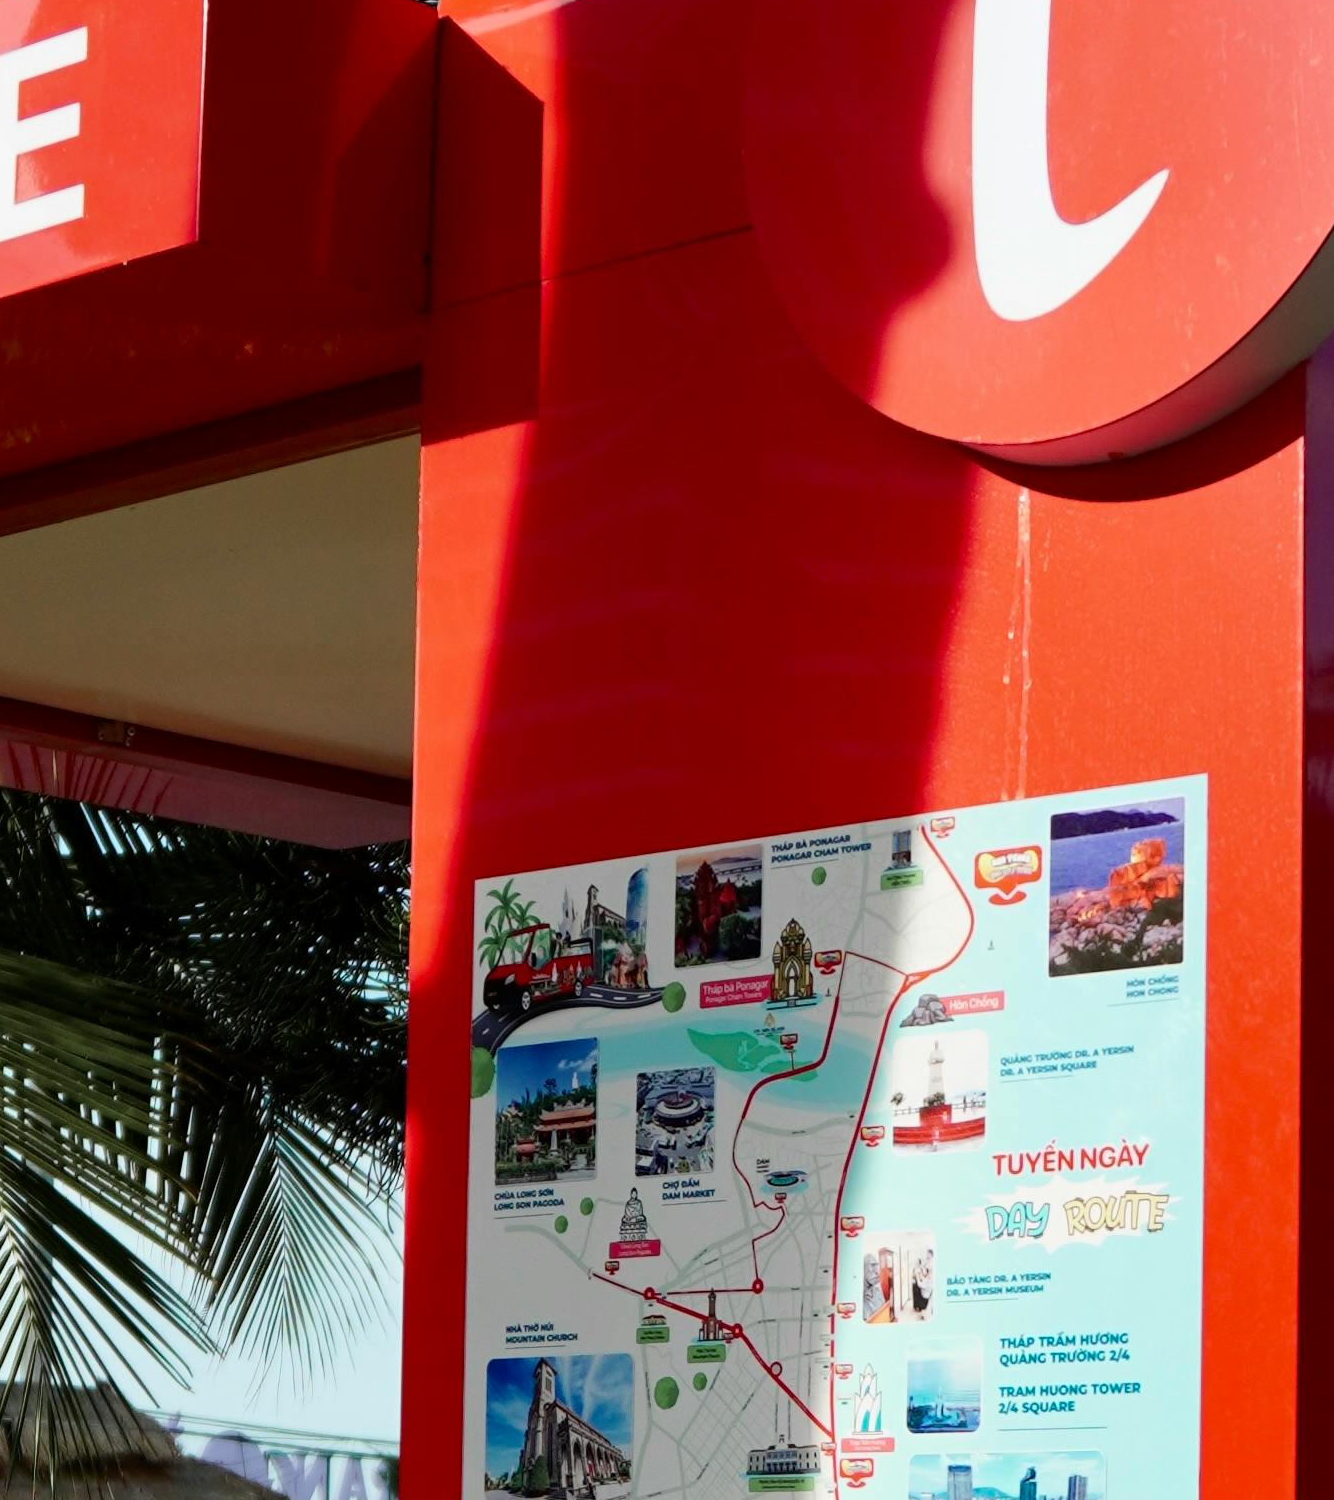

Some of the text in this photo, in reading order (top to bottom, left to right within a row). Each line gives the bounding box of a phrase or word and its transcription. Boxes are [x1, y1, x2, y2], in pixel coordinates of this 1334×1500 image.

[809, 834, 851, 846] PONAGAR
[771, 842, 872, 864] PONAGAR CHAM TOWER
[1102, 1045, 1135, 1056] YERSIN
[1026, 1063, 1058, 1074] YERSIN
[1060, 1060, 1097, 1072] SQUARE
[992, 1139, 1149, 1176] TUYẾN NGÀY
[662, 1188, 715, 1201] DAM MARKET
[985, 1190, 1170, 1240] DAY ROUTE
[1019, 1272, 1051, 1281] YERSIN
[972, 1287, 1003, 1296] YERSIN
[1005, 1285, 1044, 1294] MUSEUM
[506, 1332, 578, 1344] MOUNTAIN CHURCH
[1000, 1332, 1129, 1349] THÁP HƯƠNG
[1109, 1348, 1131, 1362] 2/4
[998, 1382, 1141, 1398] TRAM HUONG TOWER
[998, 1401, 1076, 1415] 2/4 SQUARE
